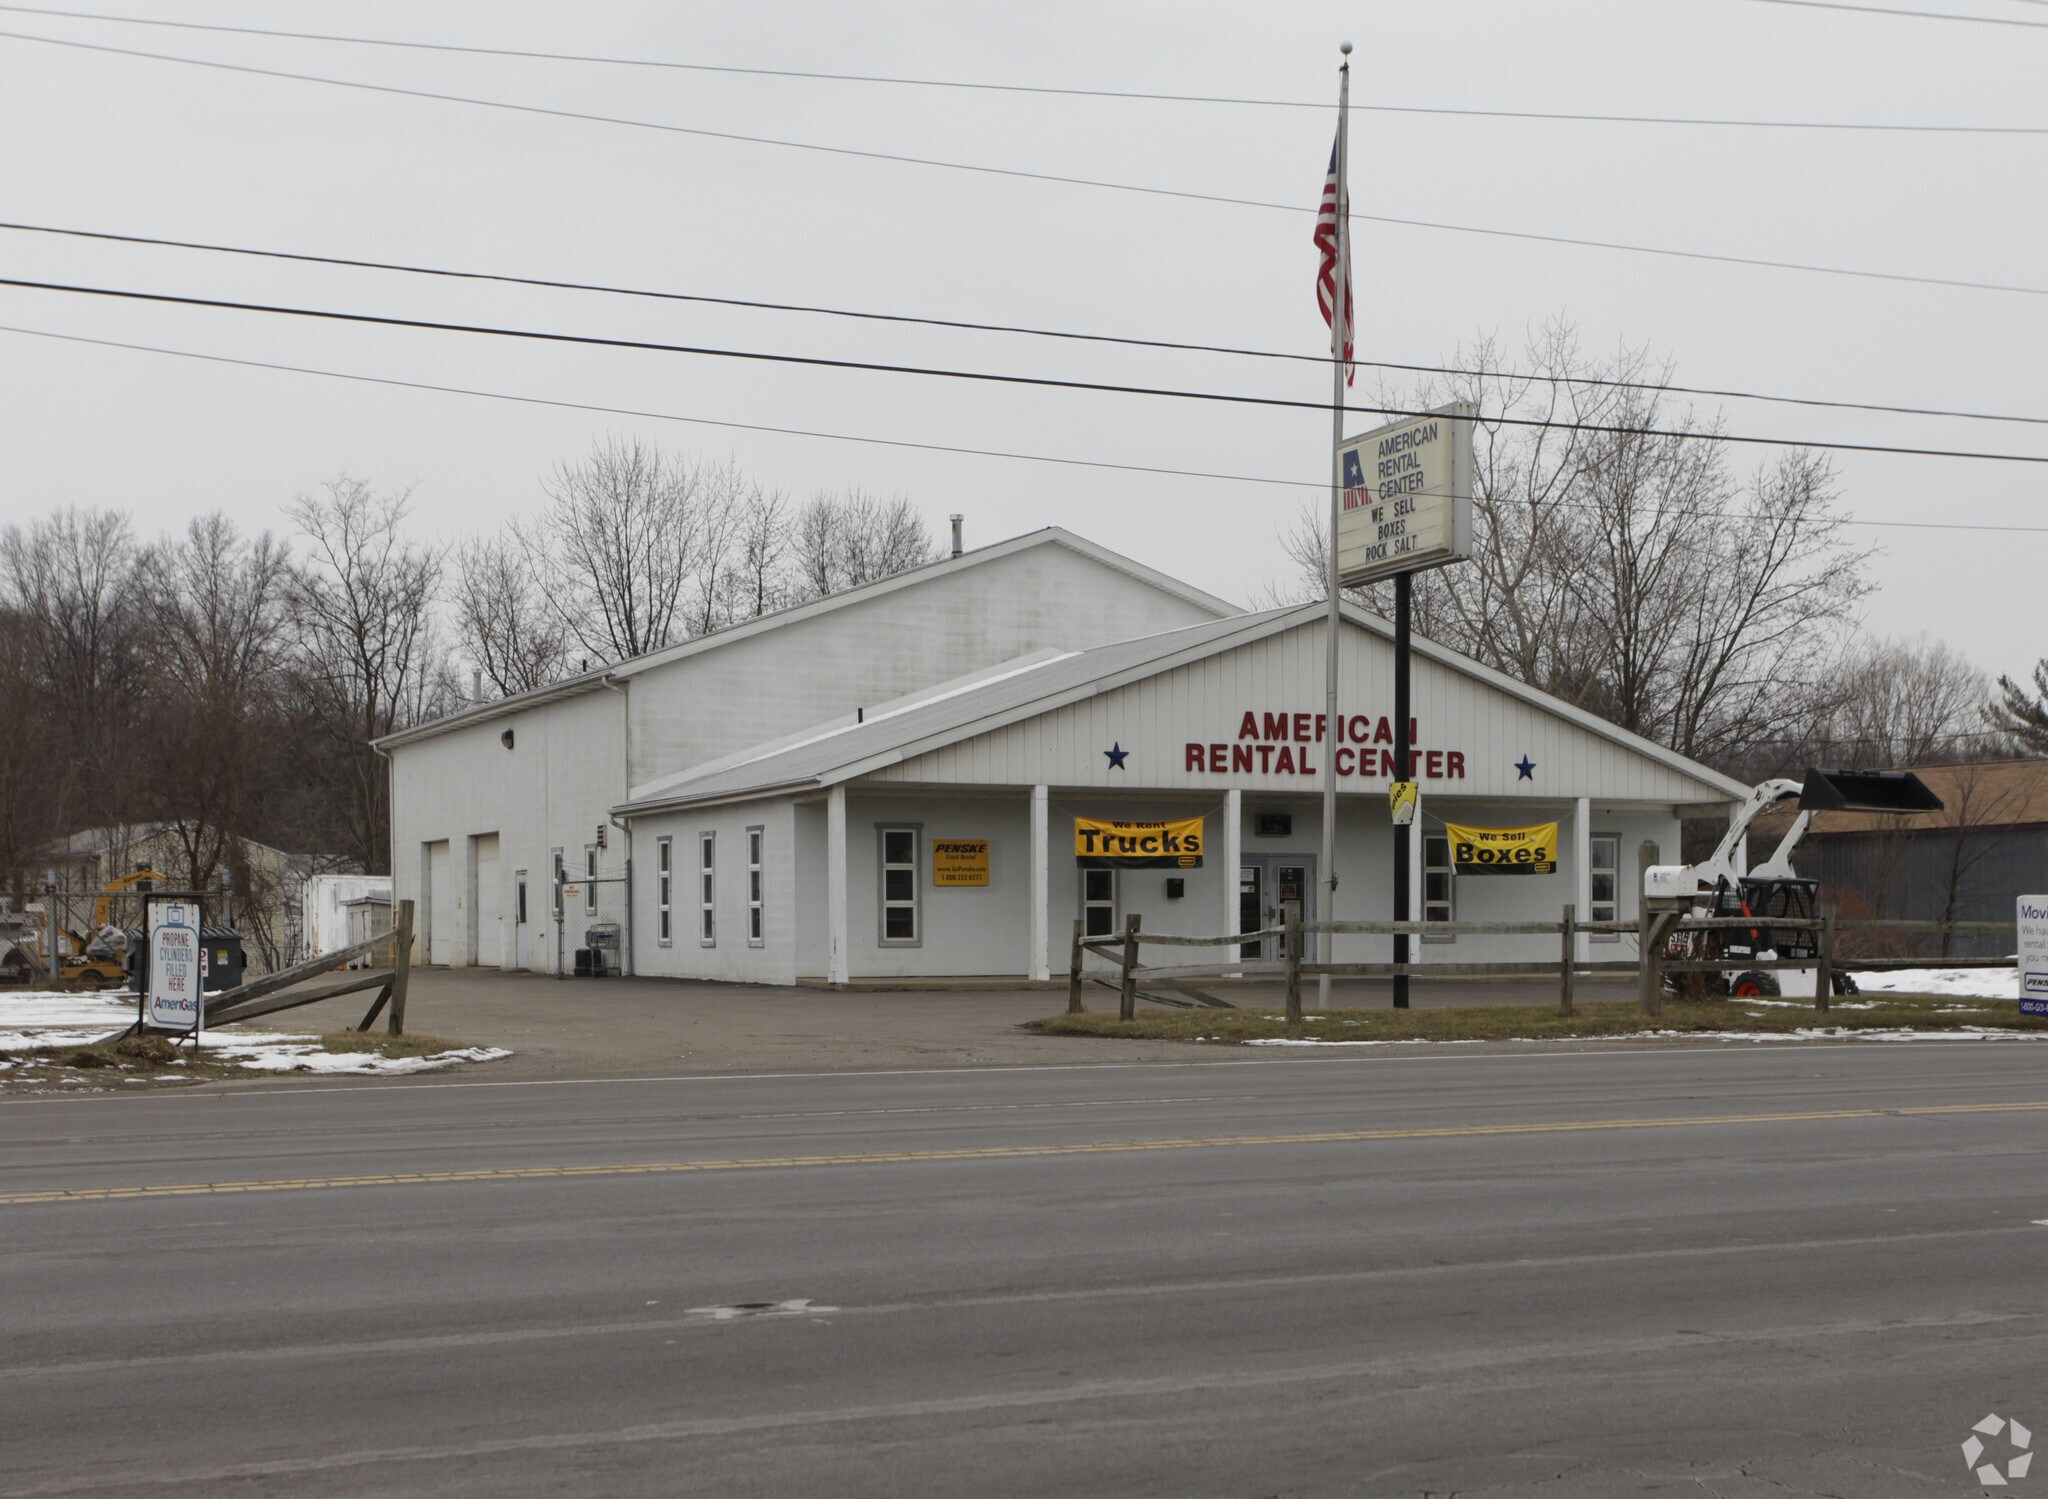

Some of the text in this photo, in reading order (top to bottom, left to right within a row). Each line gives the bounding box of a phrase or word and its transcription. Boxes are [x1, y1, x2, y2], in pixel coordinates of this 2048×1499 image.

[1378, 422, 1438, 458] AMERICAN
[1378, 451, 1421, 479] RENTAL
[1378, 471, 1424, 500] CENTER
[1371, 497, 1416, 523] WE SELL
[1378, 519, 1406, 540] BOXES
[1365, 534, 1417, 562] ROCK SALT
[1185, 743, 1465, 778] RENTAL CENTER
[1112, 821, 1166, 829] We Rent
[1078, 829, 1200, 853] Trucks
[1479, 832, 1526, 841] We Sell
[935, 844, 987, 853] PENSKE
[1456, 842, 1546, 863] Boxes
[2021, 925, 2034, 935] We
[162, 932, 189, 947] PROPANE
[2024, 939, 2046, 949] rental
[159, 947, 193, 962] CYLINDERS
[2025, 954, 2039, 965] you
[165, 963, 187, 978] FILLED
[168, 977, 185, 992] HERE
[154, 996, 197, 1011] AmeriGas
